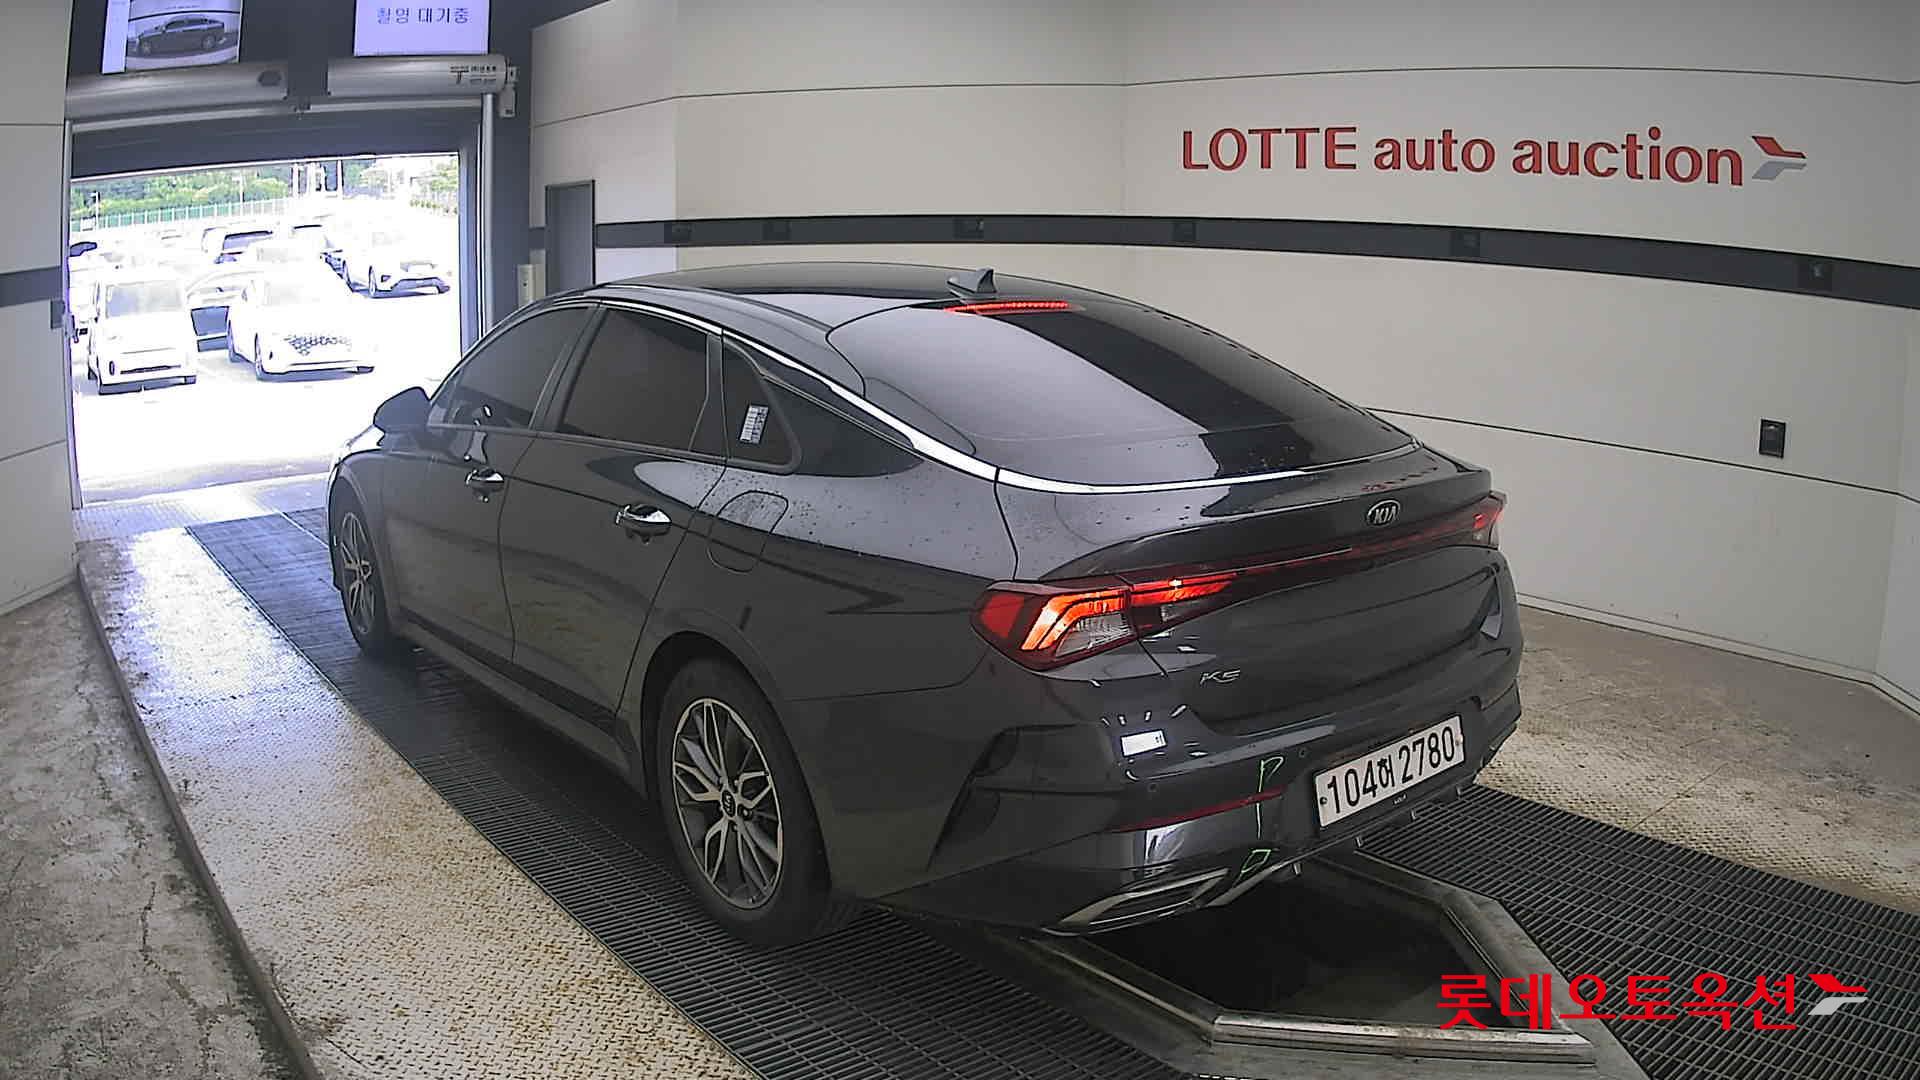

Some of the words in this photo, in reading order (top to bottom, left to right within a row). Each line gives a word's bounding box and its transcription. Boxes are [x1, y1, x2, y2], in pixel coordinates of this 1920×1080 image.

[419, 8, 468, 24] 대기중
[1184, 128, 1357, 171] LOTTE
[1376, 133, 1495, 171] auto
[1514, 129, 1742, 186] auction
[1372, 503, 1397, 525] KIA
[1200, 670, 1241, 684] K5
